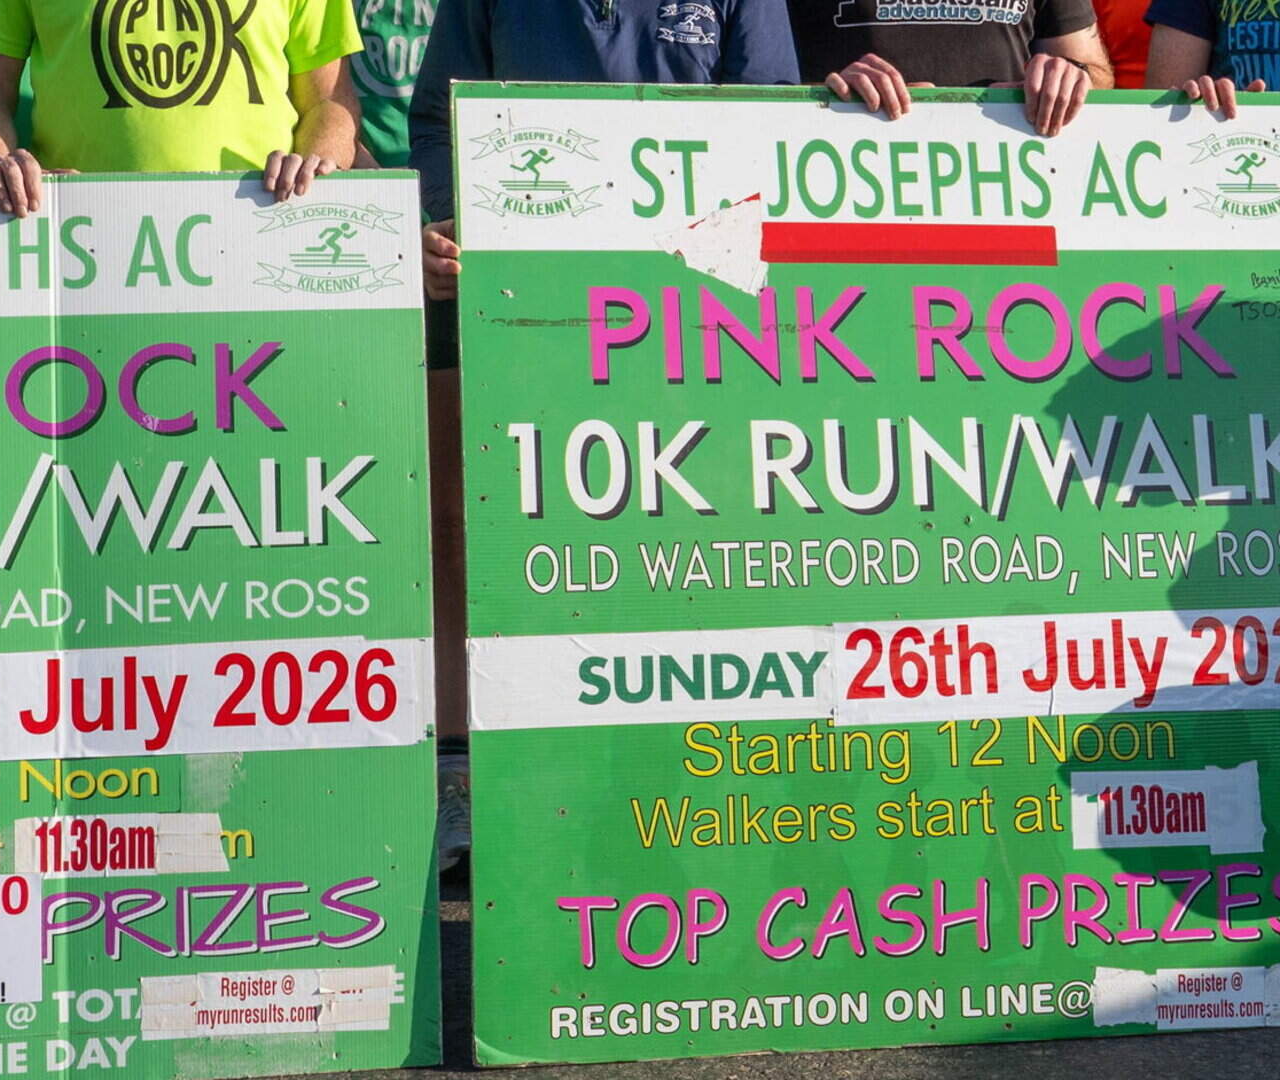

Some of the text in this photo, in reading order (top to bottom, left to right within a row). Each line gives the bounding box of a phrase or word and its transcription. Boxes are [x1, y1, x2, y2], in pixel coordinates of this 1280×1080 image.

[877, 3, 1022, 25] adventure race
[767, 138, 1052, 220] JOSEPHS
[1081, 140, 1168, 220] AC
[303, 207, 348, 218] JOSEPHS
[504, 197, 572, 216] KILKENNY
[124, 214, 213, 289] AC
[298, 275, 360, 293] KILKENNY
[587, 282, 1240, 387] PINK ROCK
[507, 419, 721, 520] 10K
[524, 542, 620, 595] OLD
[639, 536, 921, 591] WATERFORD
[941, 533, 1079, 596] ROAD,
[1101, 529, 1198, 581] NEW
[105, 581, 228, 627] NEW
[245, 575, 371, 620] ROSS
[577, 650, 829, 706] SUNDAY
[844, 624, 999, 701] 26th
[1022, 618, 1169, 709] July
[19, 656, 188, 752] July
[213, 648, 398, 728] 2026
[682, 714, 1177, 786] Starting 12 Noon
[19, 758, 160, 802] Noon
[631, 783, 1208, 849] Walkers start at 11.30am
[35, 818, 156, 874] 11.30am
[42, 876, 386, 965] PRIZES
[556, 887, 730, 970] TOP
[756, 877, 991, 961] CASH
[220, 975, 296, 1002] Register @
[1177, 971, 1243, 997] Register @
[6, 1002, 37, 1030] @
[196, 1003, 319, 1030] myrunresults.com
[551, 989, 867, 1039] REGISTRATION
[883, 987, 946, 1025] ON
[1156, 999, 1264, 1025] myrunresults.com
[46, 1034, 137, 1071] DAY
